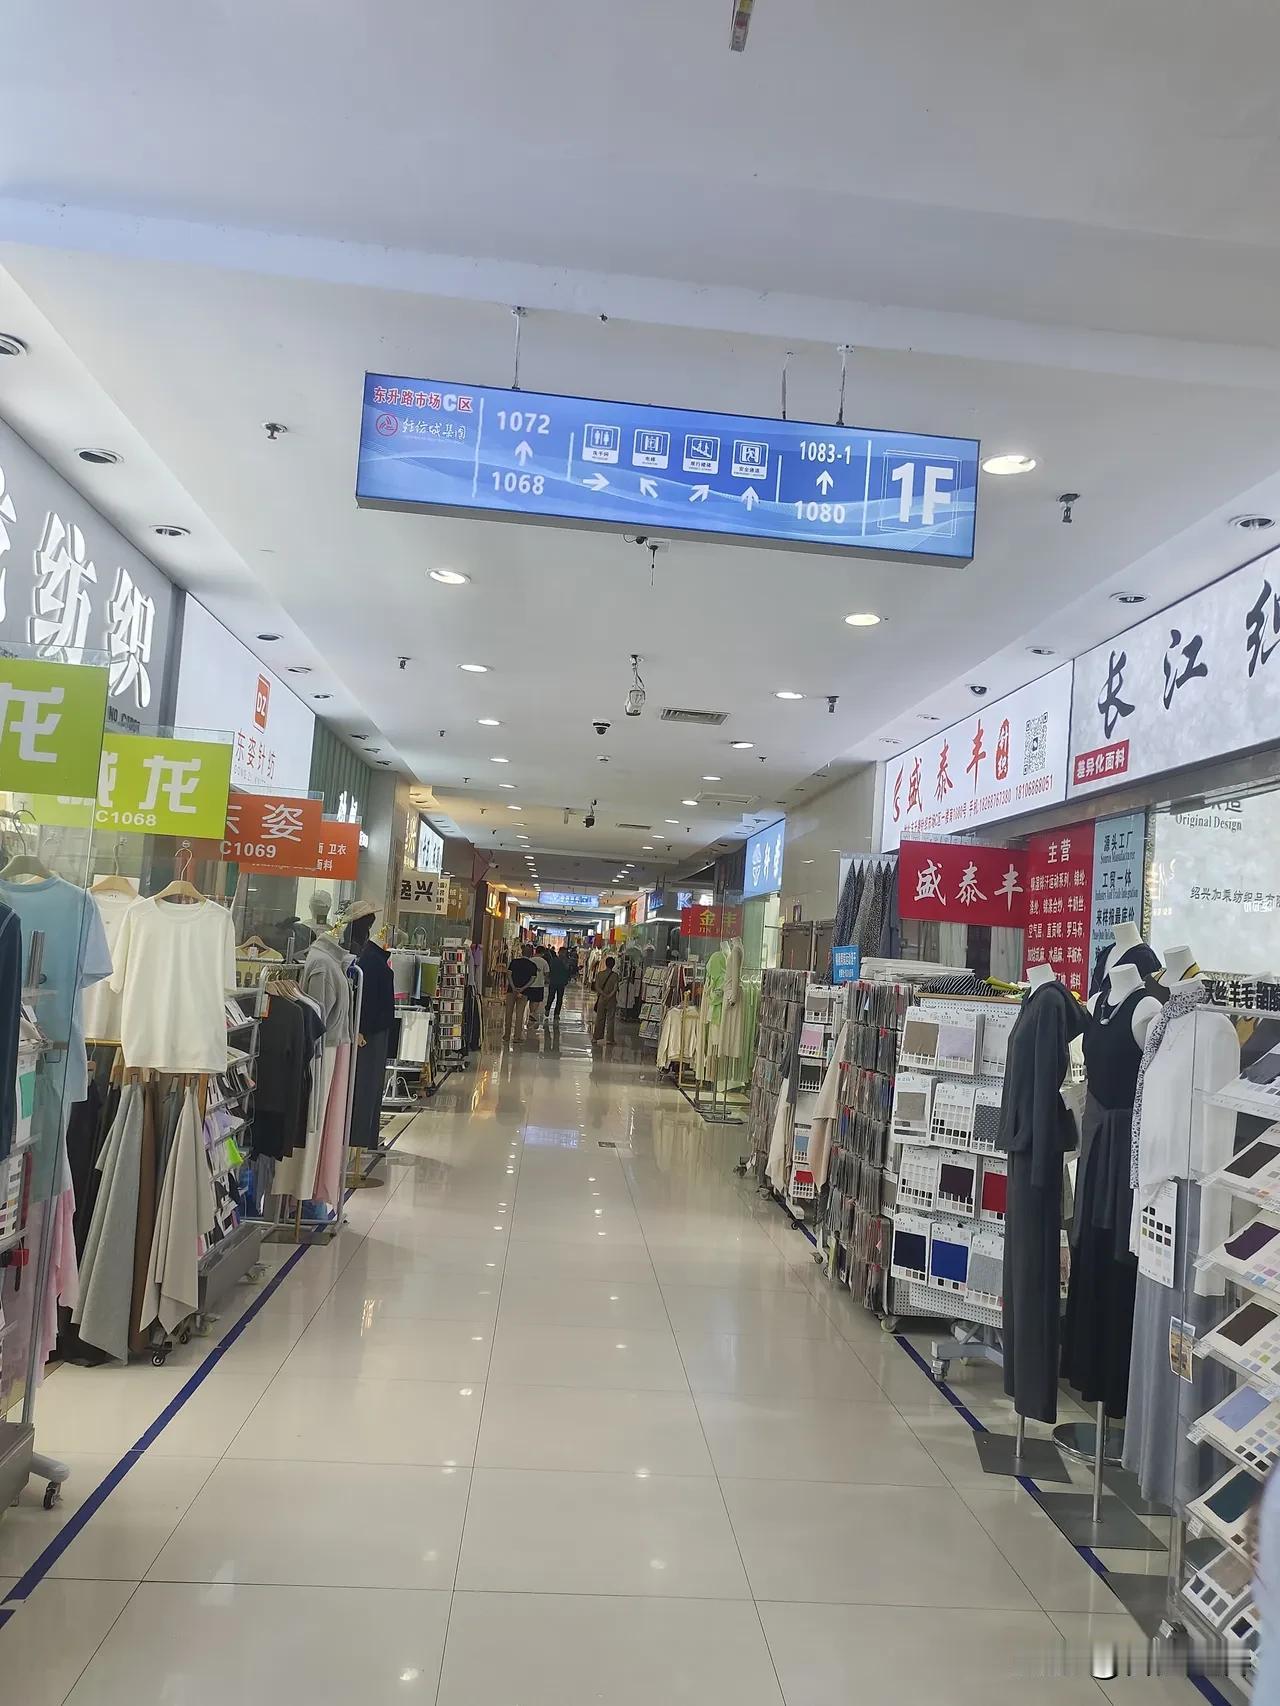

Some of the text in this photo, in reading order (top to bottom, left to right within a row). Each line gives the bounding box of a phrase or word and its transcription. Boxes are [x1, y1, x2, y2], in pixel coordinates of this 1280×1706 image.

[374, 386, 473, 413] 东升路市场C区
[497, 411, 551, 435] 1072
[800, 440, 851, 465] 1083-1
[492, 471, 545, 495] 1068
[891, 462, 954, 525] 1F
[794, 500, 846, 525] 1080
[906, 718, 987, 814] 盛泰丰
[95, 810, 157, 826] C1068
[1176, 813, 1242, 833] Original Design
[219, 840, 277, 858] C1069
[1048, 839, 1071, 864] 主营
[1104, 831, 1133, 852] 源头工厂
[914, 858, 1024, 912] 盛泰丰
[1102, 868, 1132, 889] 工贸一体
